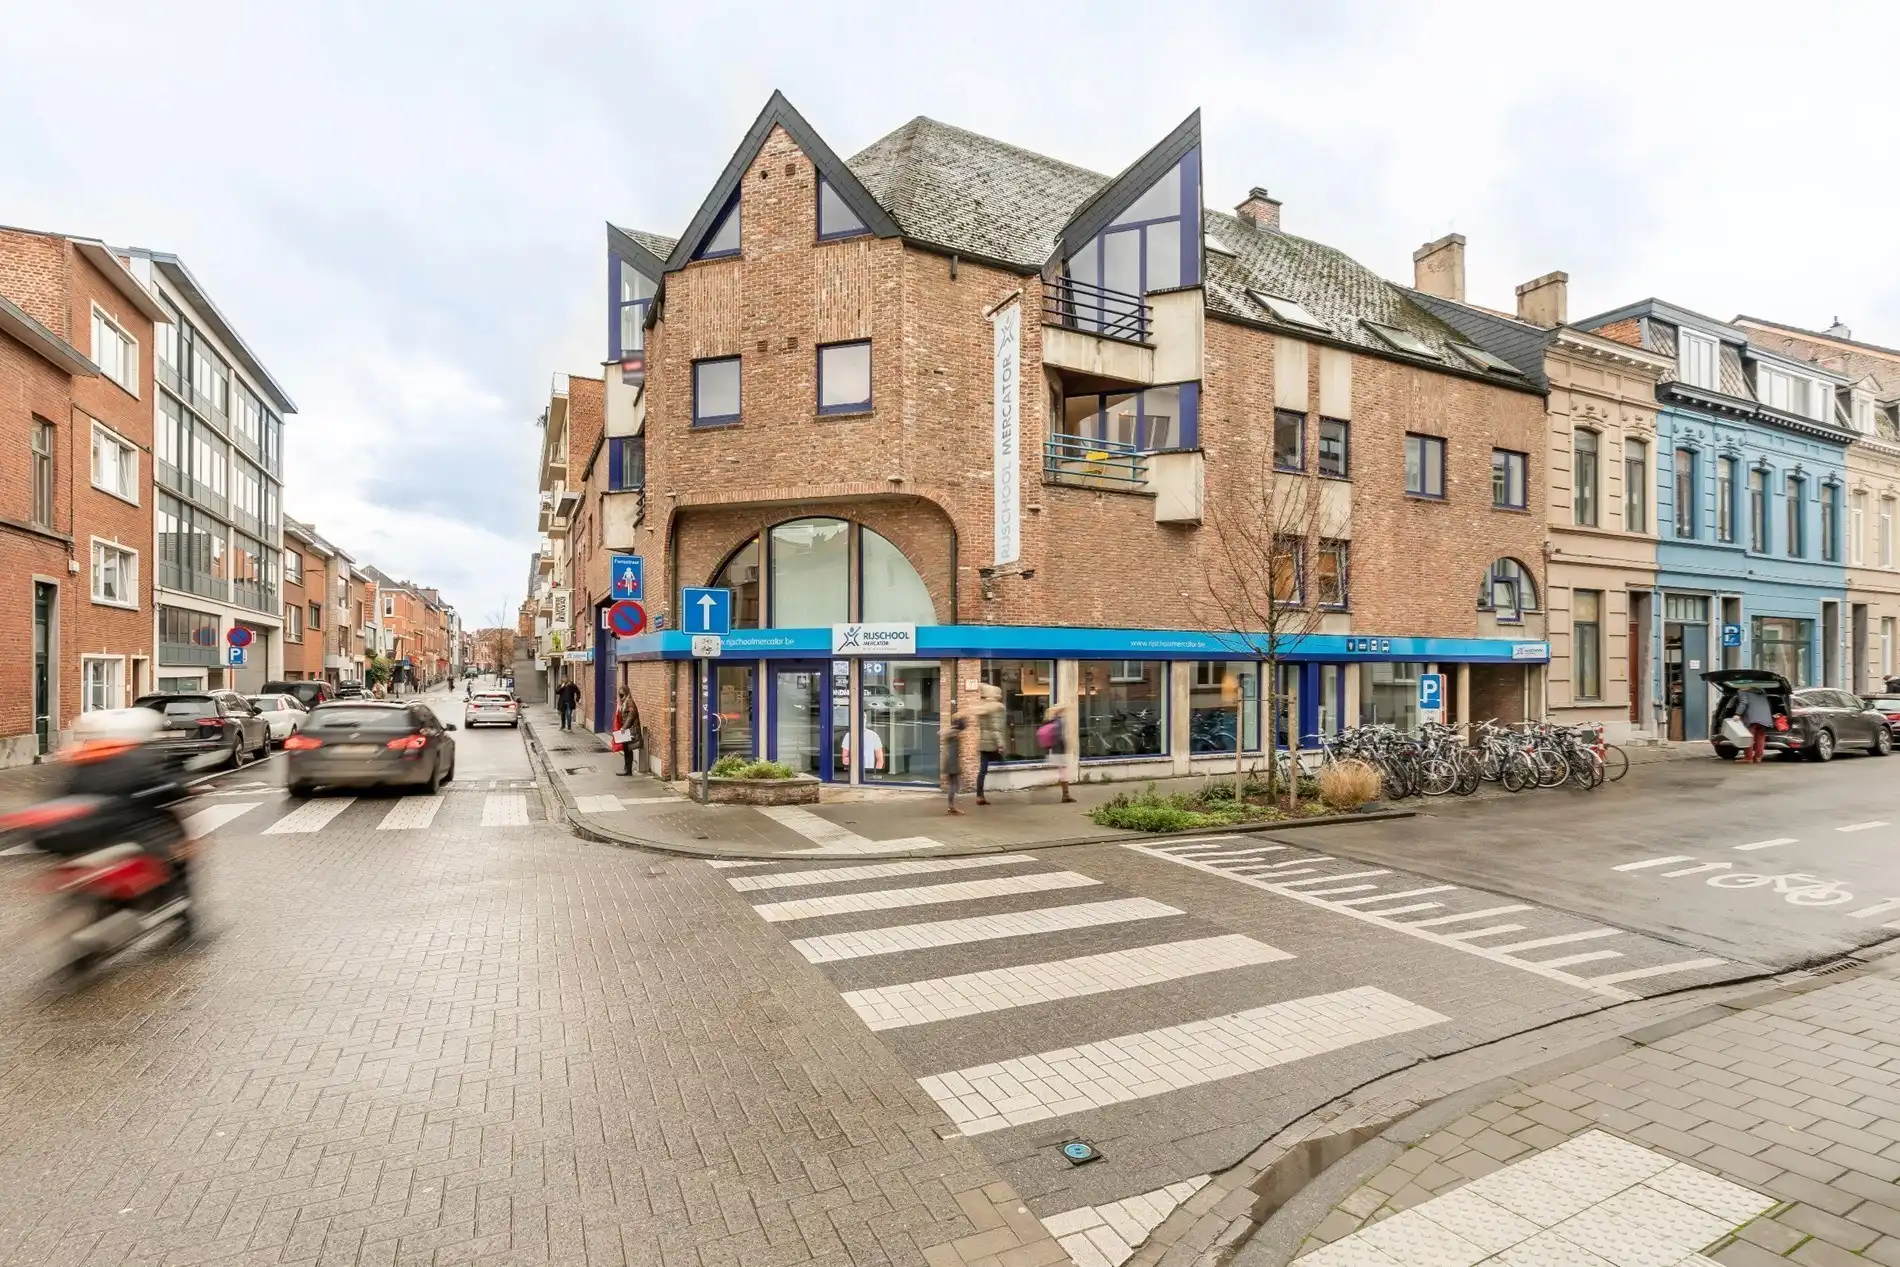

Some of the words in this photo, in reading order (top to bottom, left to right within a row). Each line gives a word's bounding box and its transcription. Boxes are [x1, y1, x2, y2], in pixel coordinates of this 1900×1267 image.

[1002, 354, 1012, 455] MERCATOR
[1001, 460, 1011, 559] RIJSCHOOL
[720, 637, 795, 647] w.rijschoolmercator.be
[863, 632, 910, 640] RIJSCHOOL
[230, 648, 241, 661] P
[507, 679, 513, 687] P
[1423, 680, 1438, 703] P
